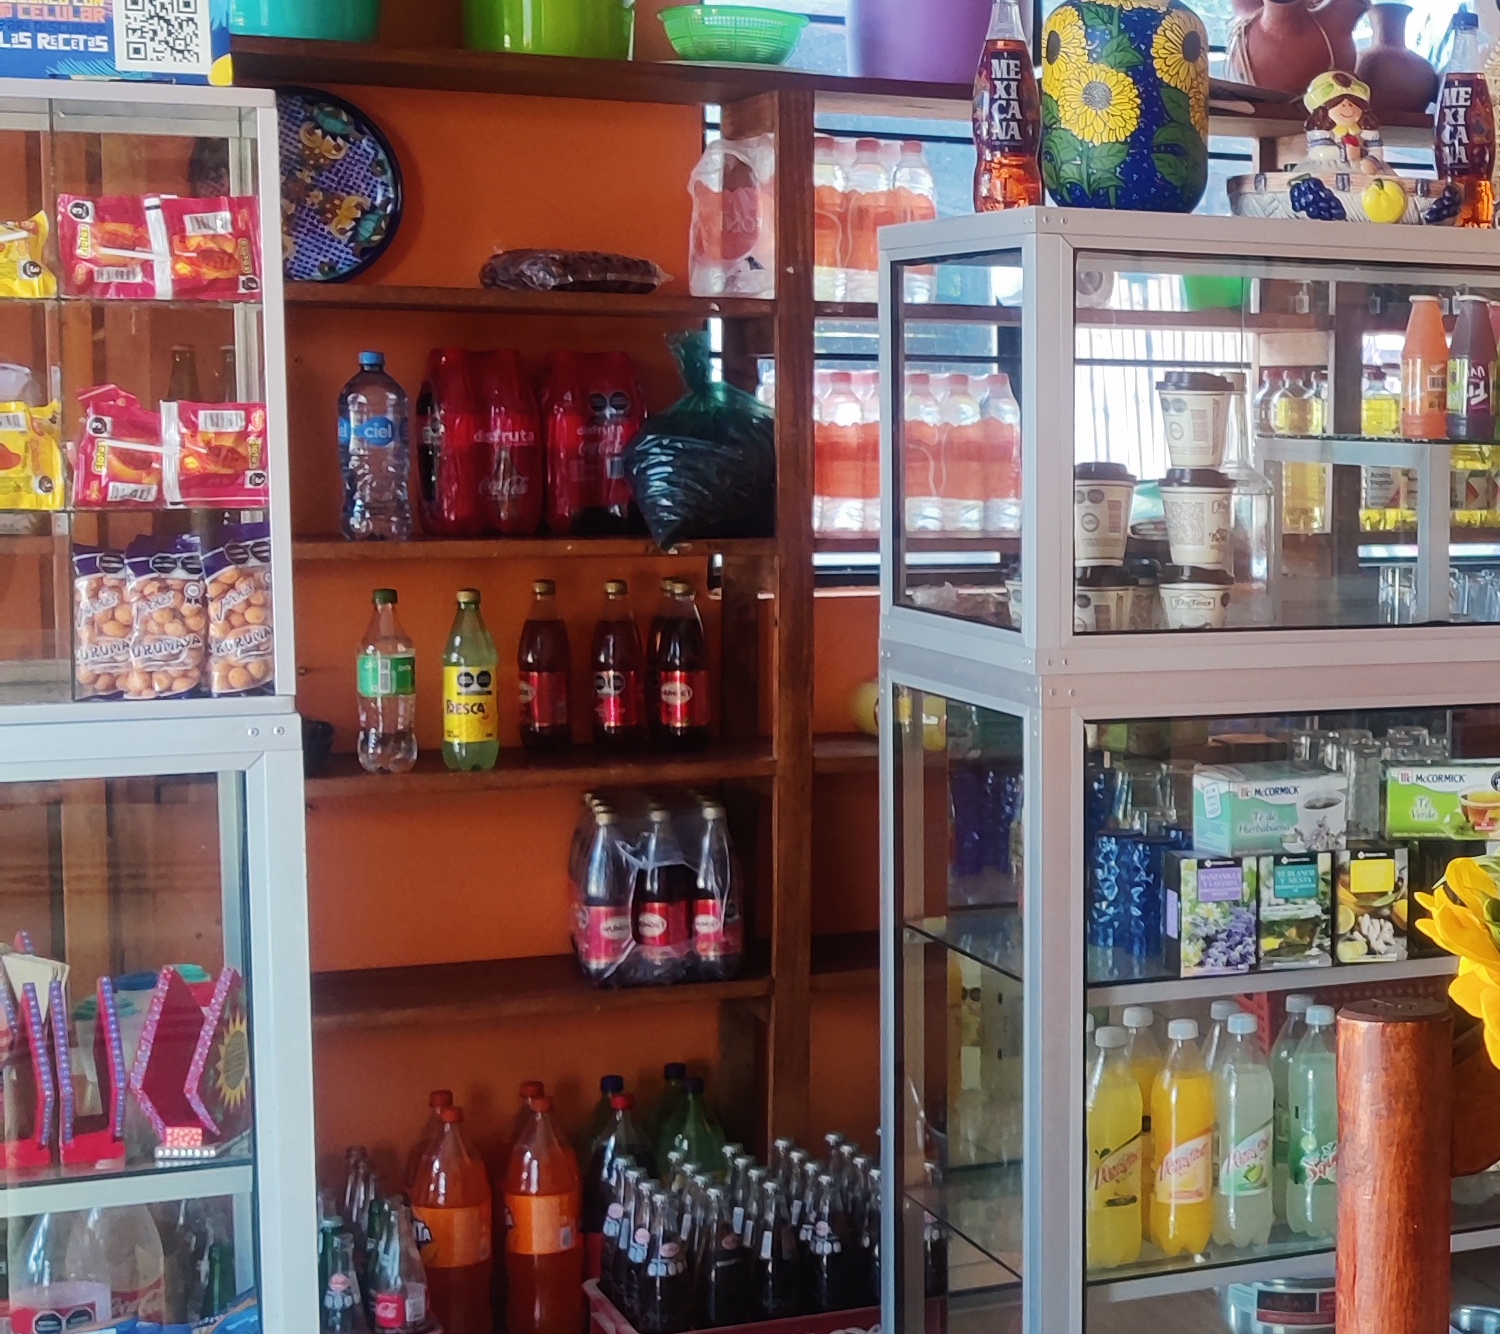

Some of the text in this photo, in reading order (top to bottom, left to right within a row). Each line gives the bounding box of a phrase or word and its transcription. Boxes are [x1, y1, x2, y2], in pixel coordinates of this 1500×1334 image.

[364, 423, 392, 439] ciel
[132, 632, 201, 658] URUMAYA
[1415, 773, 1466, 783] McCORMICK
[1254, 785, 1300, 797] McCORMICK
